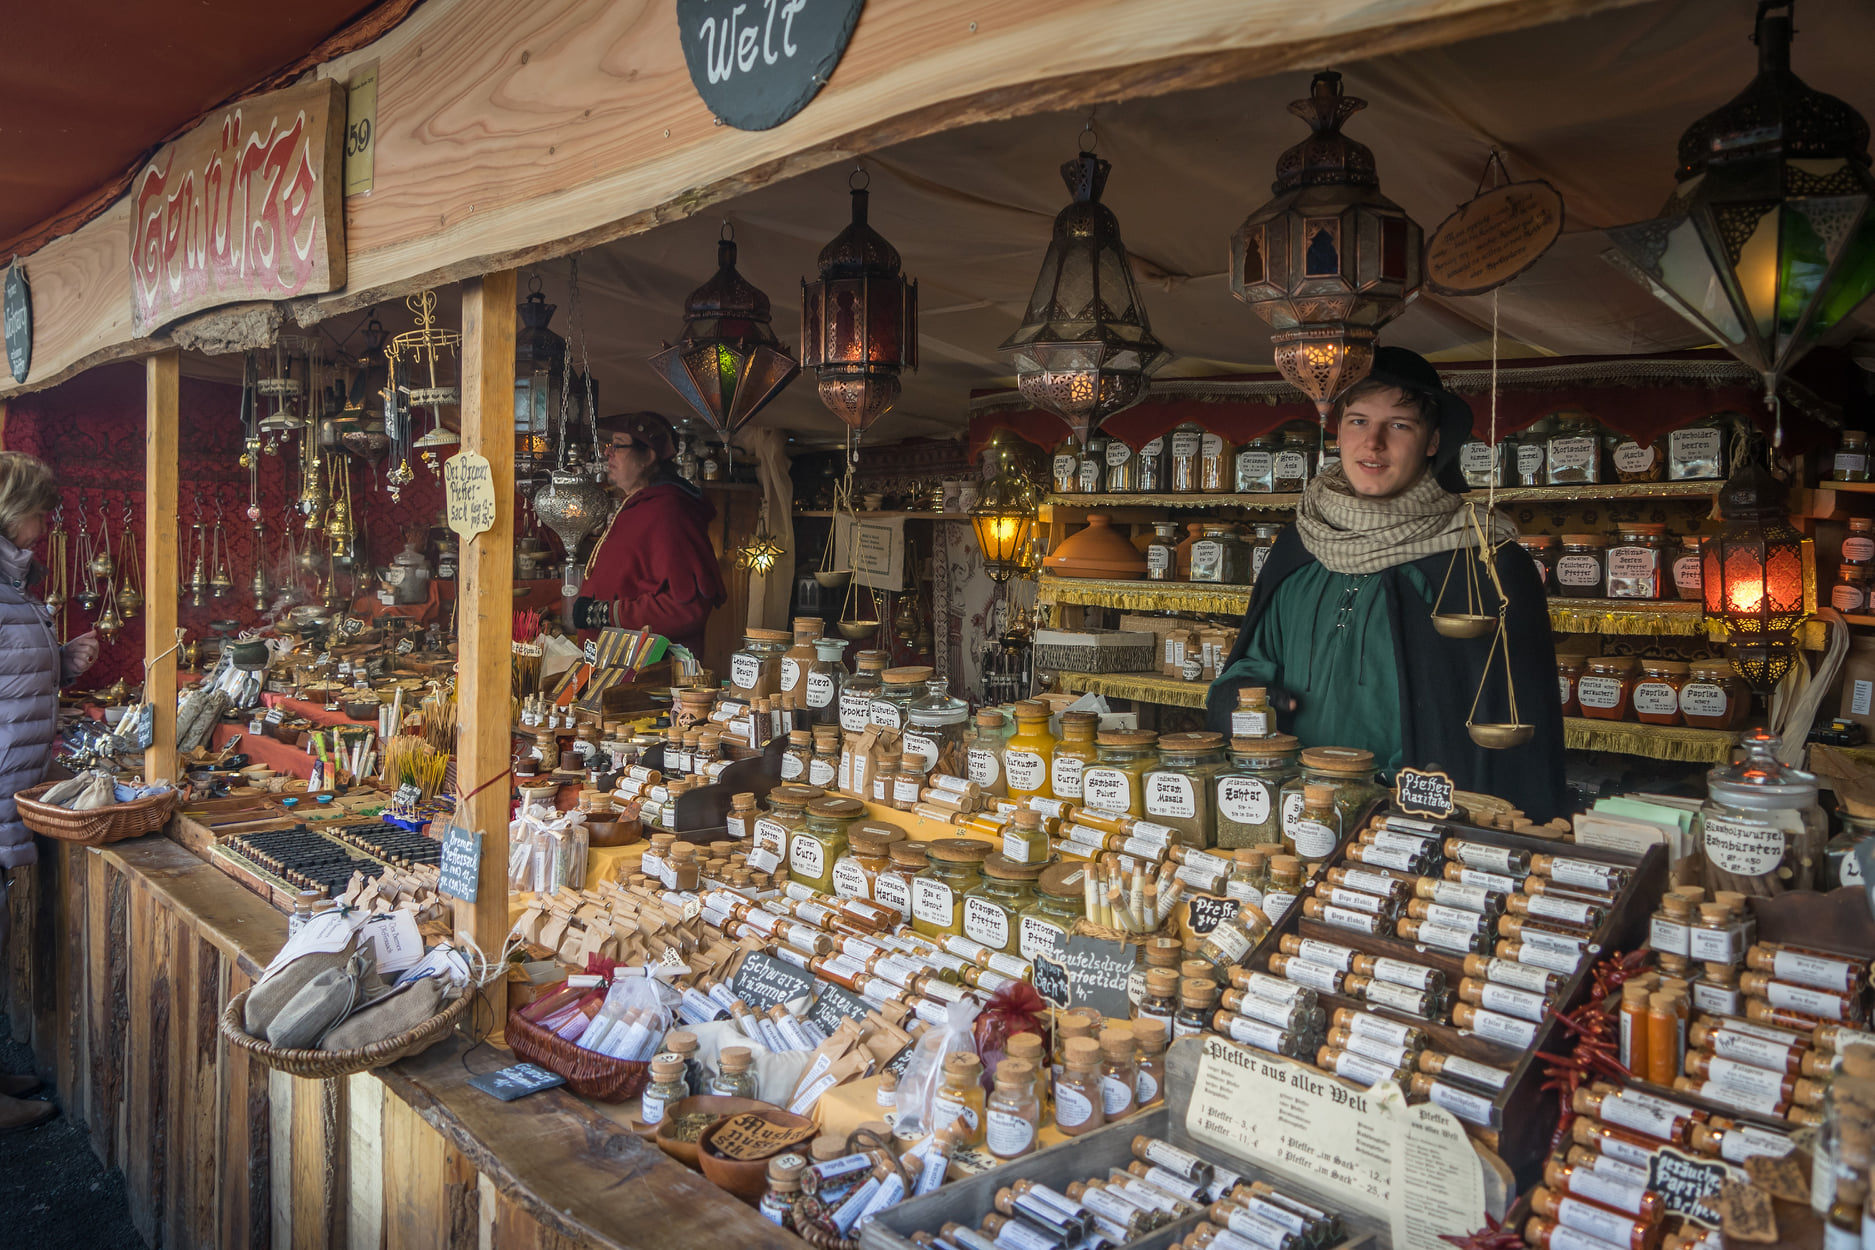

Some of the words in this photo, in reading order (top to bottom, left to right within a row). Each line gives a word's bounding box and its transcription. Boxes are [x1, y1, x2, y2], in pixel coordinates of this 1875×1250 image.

[700, 0, 807, 85] Welt
[347, 118, 372, 157] 59
[131, 108, 317, 312] Gewürze
[1564, 569, 1591, 577] Pfeffer
[1640, 689, 1669, 697] Paprika
[1687, 689, 1718, 698] Paprika
[1007, 756, 1038, 768] Kurkuma
[1057, 774, 1081, 785] Curry
[1156, 783, 1182, 793] Garam
[1405, 773, 1451, 795] Pfeffer
[1096, 789, 1117, 798] Pulver
[1156, 794, 1184, 804] Masala
[1225, 787, 1261, 802] Zahtar
[1402, 788, 1451, 810] Raritäten
[450, 830, 473, 852] Bremer
[441, 841, 478, 872] Pfeffersack
[795, 846, 817, 863] Curry
[835, 870, 863, 883] Tandoori-
[876, 887, 905, 906] Harissa
[969, 899, 1004, 918] Orangen-
[1197, 899, 1239, 919] Pfeffe
[971, 912, 1001, 930] Pfeffer
[1069, 969, 1128, 991] afoetida
[1209, 1040, 1257, 1072] Pfeffer
[1261, 1064, 1287, 1083] aus
[1290, 1074, 1325, 1097] aller
[1329, 1084, 1368, 1114] Welt
[1207, 1107, 1233, 1123] Pfeffer
[1419, 1109, 1450, 1126] Pfeffer
[1204, 1119, 1231, 1138] Pfeffer
[1287, 1137, 1316, 1156] Pfeffer
[1285, 1150, 1313, 1169] Pfeffer
[1657, 1155, 1720, 1182] geräuche
